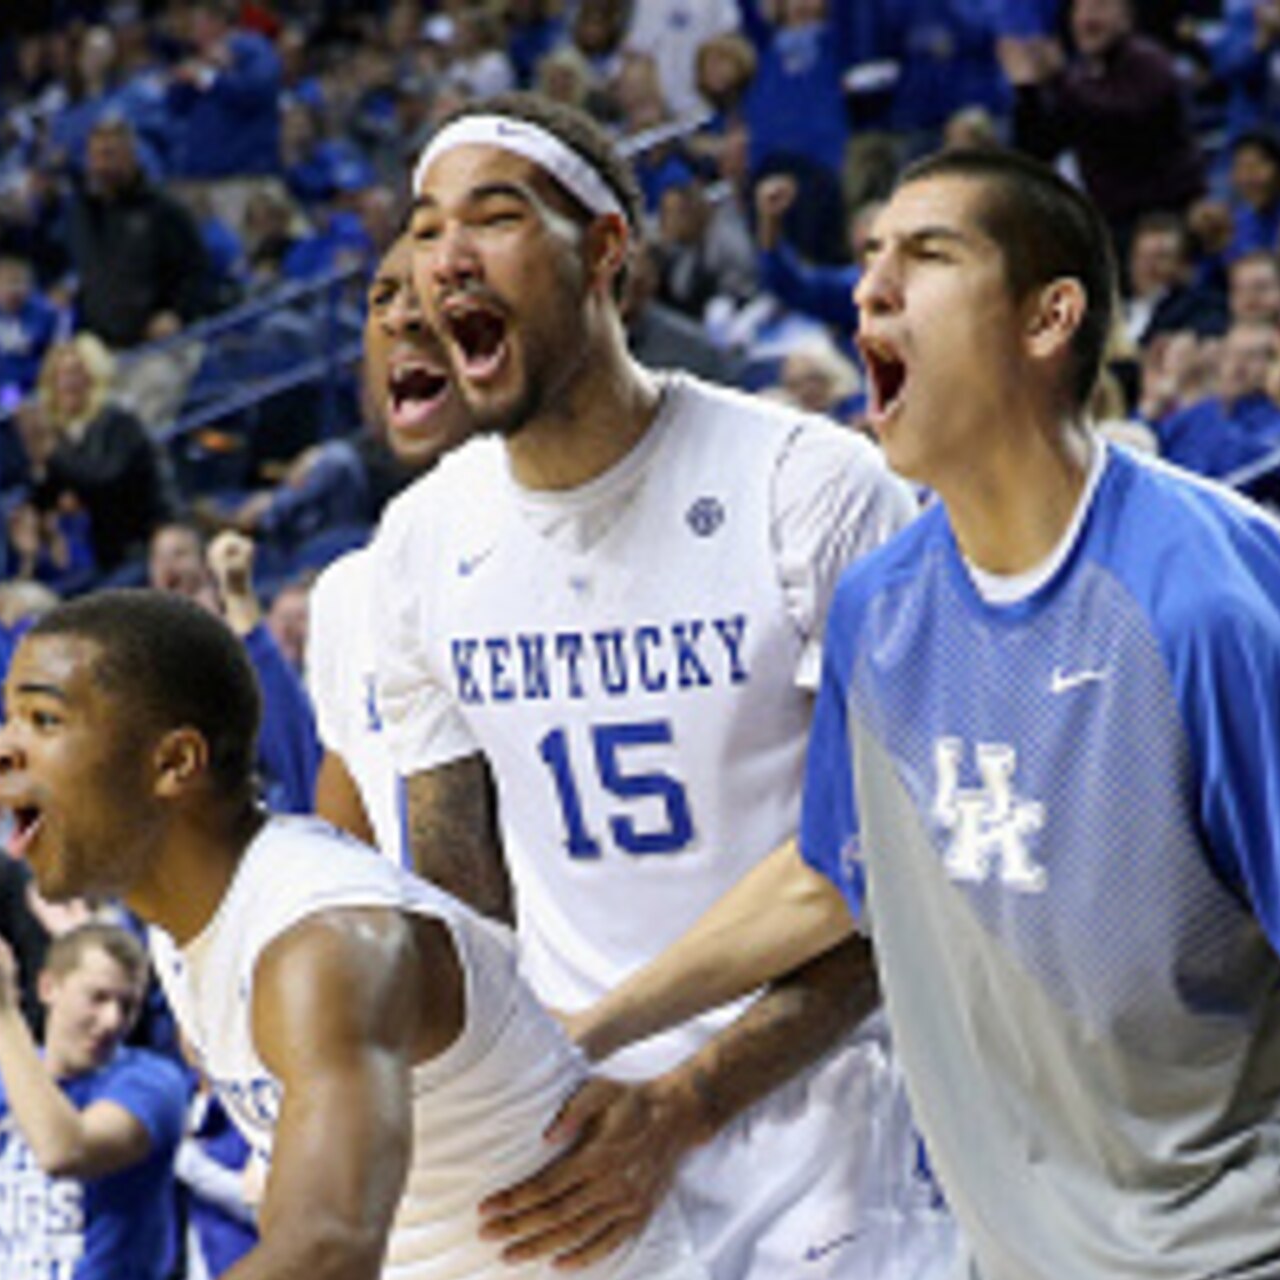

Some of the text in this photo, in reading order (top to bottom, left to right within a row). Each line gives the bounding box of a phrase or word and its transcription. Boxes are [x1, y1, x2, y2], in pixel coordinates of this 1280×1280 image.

[451, 612, 751, 706] KENTUCKY
[537, 717, 696, 862] 15
[933, 735, 1048, 894] UK
